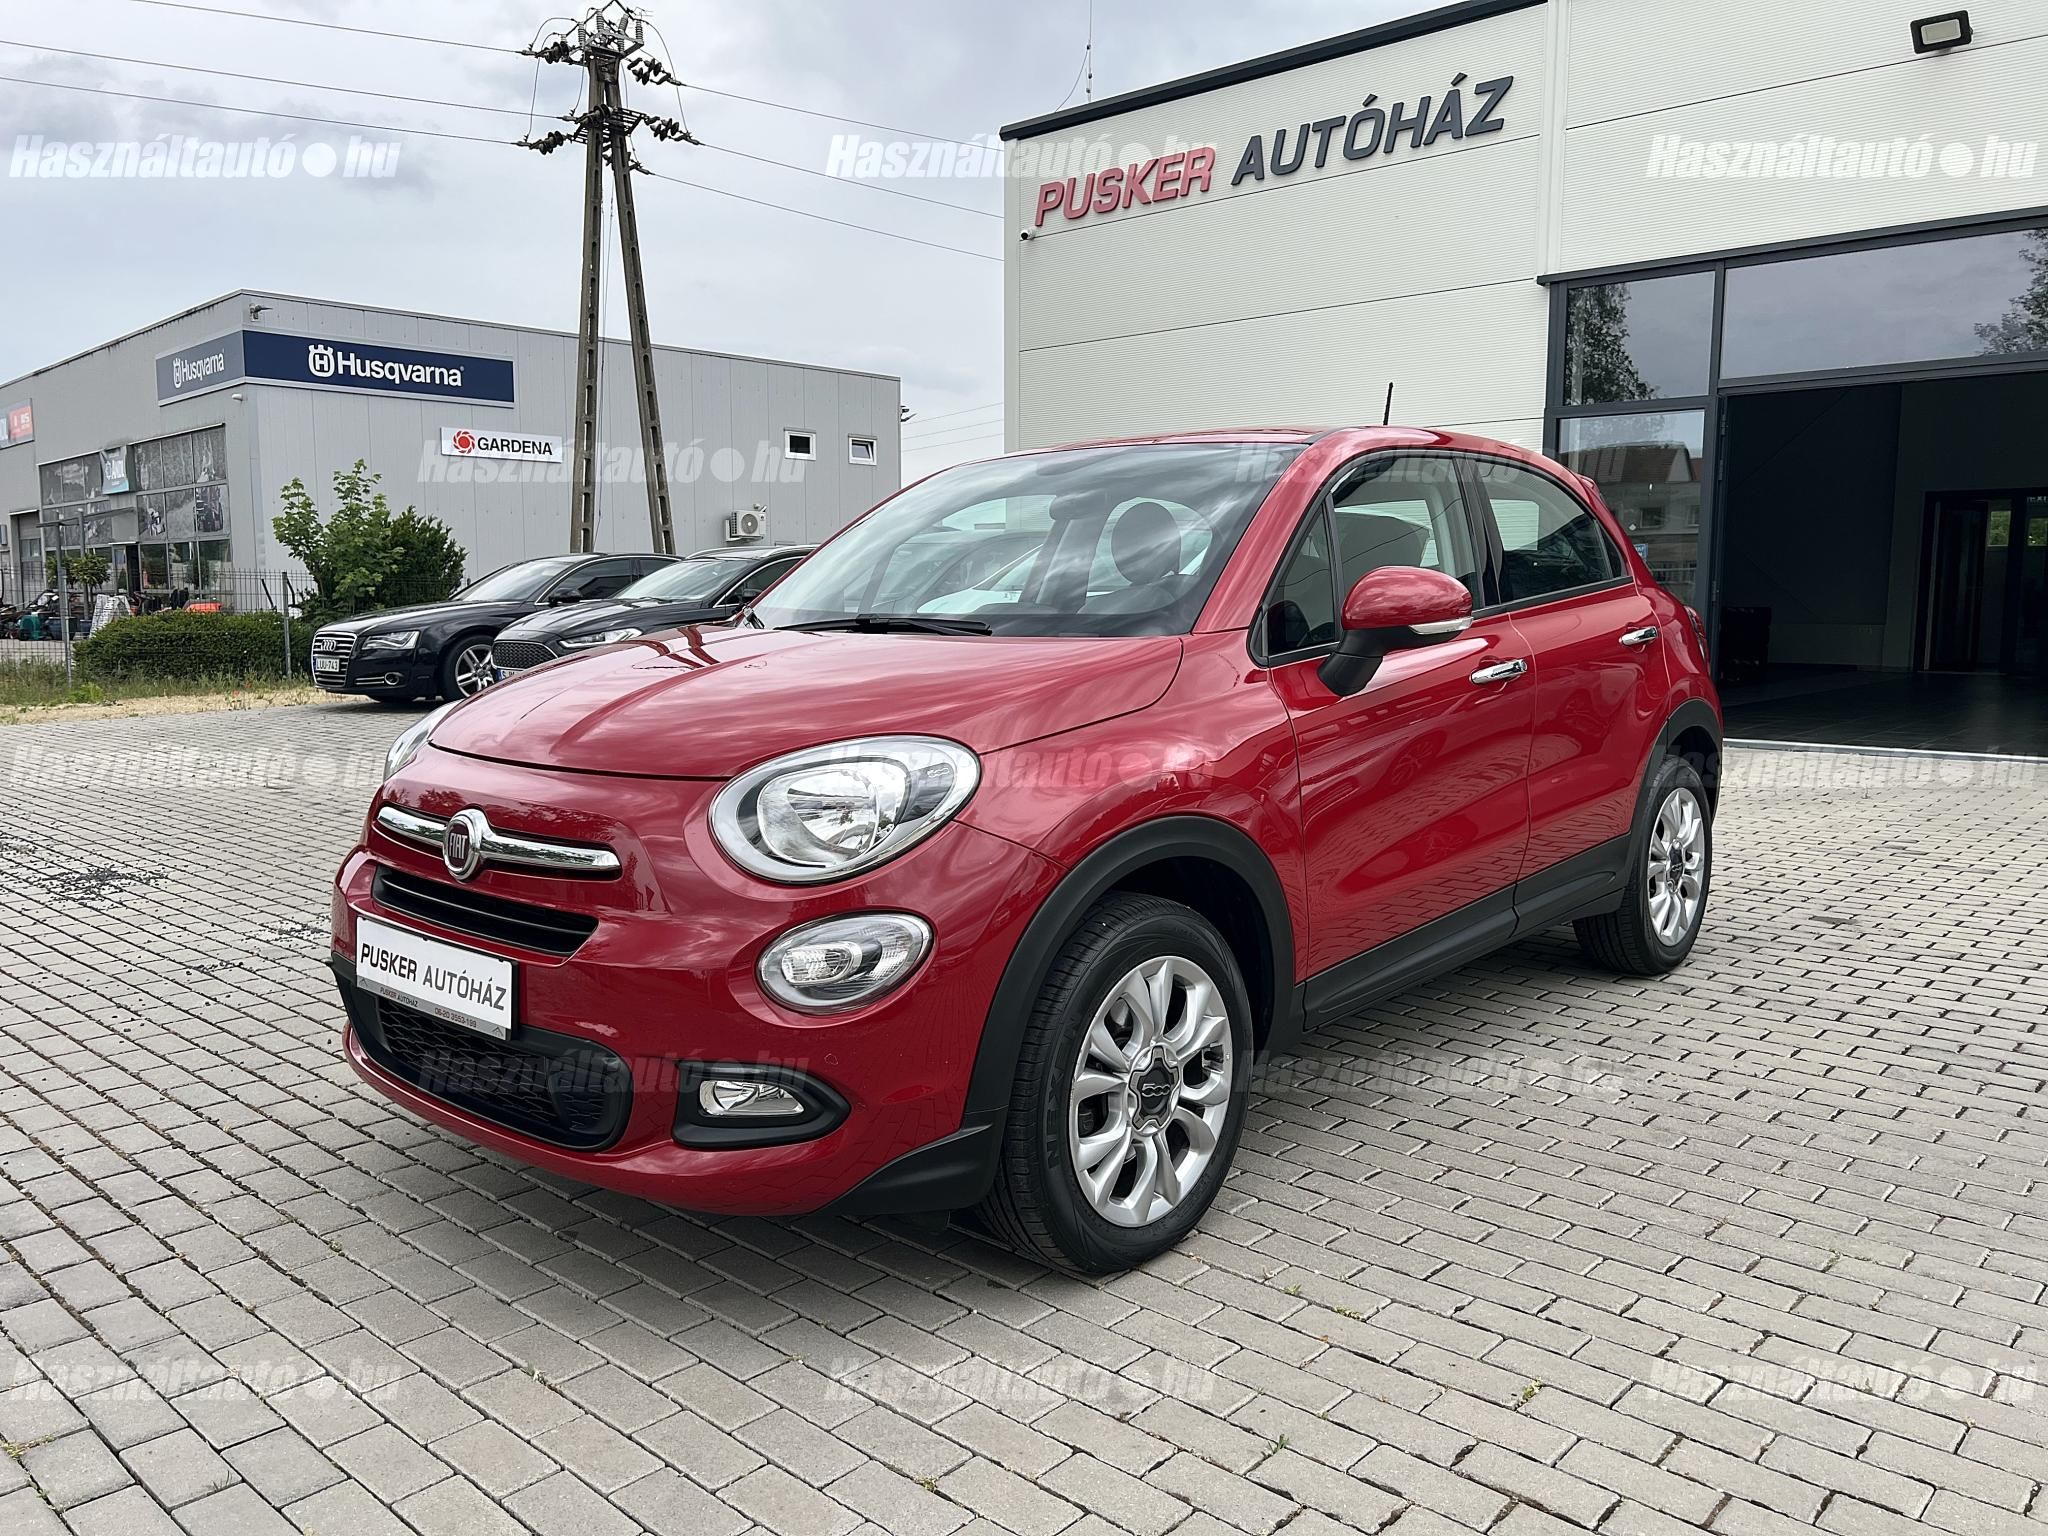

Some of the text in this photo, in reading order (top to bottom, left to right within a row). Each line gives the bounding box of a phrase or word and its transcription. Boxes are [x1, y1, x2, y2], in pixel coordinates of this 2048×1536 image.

[1035, 72, 1514, 227] PUSKER AUTÓHÁZ
[477, 436, 553, 456] GARDENA
[449, 832, 468, 859] FIAT
[361, 943, 507, 1011] PUSKER AUTÓHÁZ
